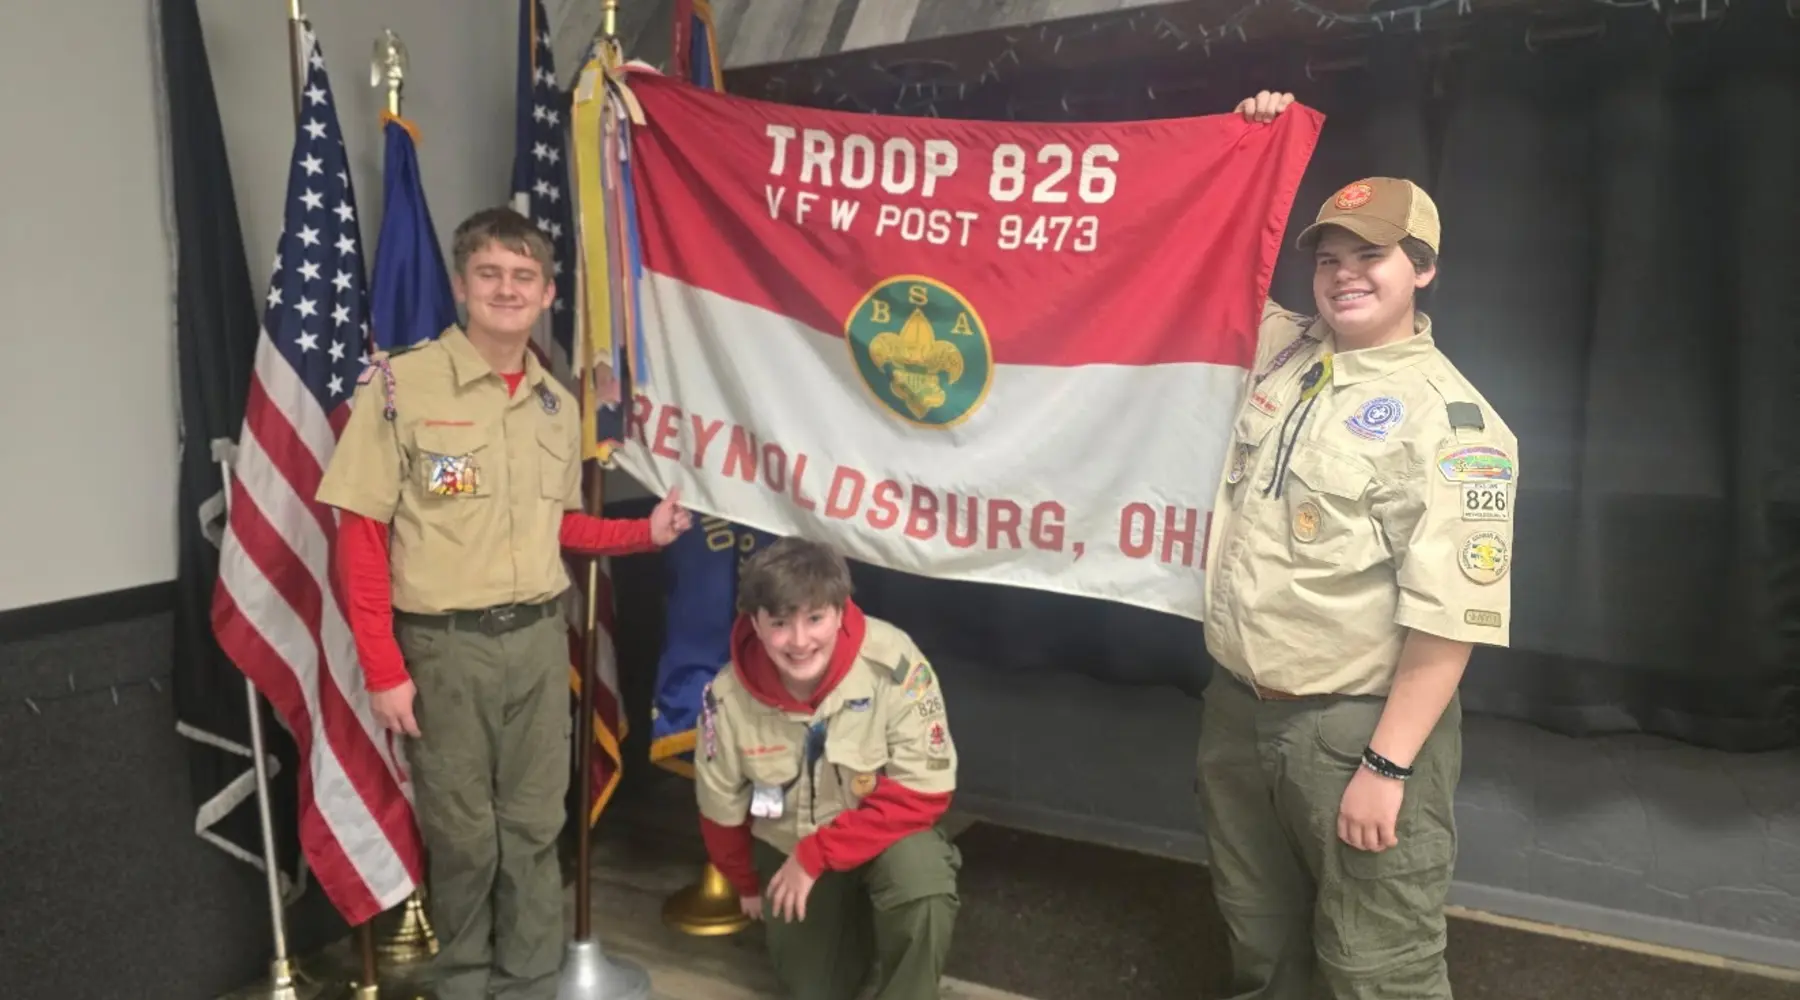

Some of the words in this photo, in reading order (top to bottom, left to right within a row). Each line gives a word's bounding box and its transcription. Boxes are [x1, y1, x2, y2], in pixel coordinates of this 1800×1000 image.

[766, 124, 958, 197] TROOP
[989, 143, 1120, 204] 826
[875, 204, 979, 247] POST
[998, 214, 1099, 252] 9473
[625, 393, 1085, 562] REYNOLDSBURG,
[1119, 502, 1214, 570] OHI
[1466, 489, 1506, 511] 826
[918, 696, 942, 718] 826
